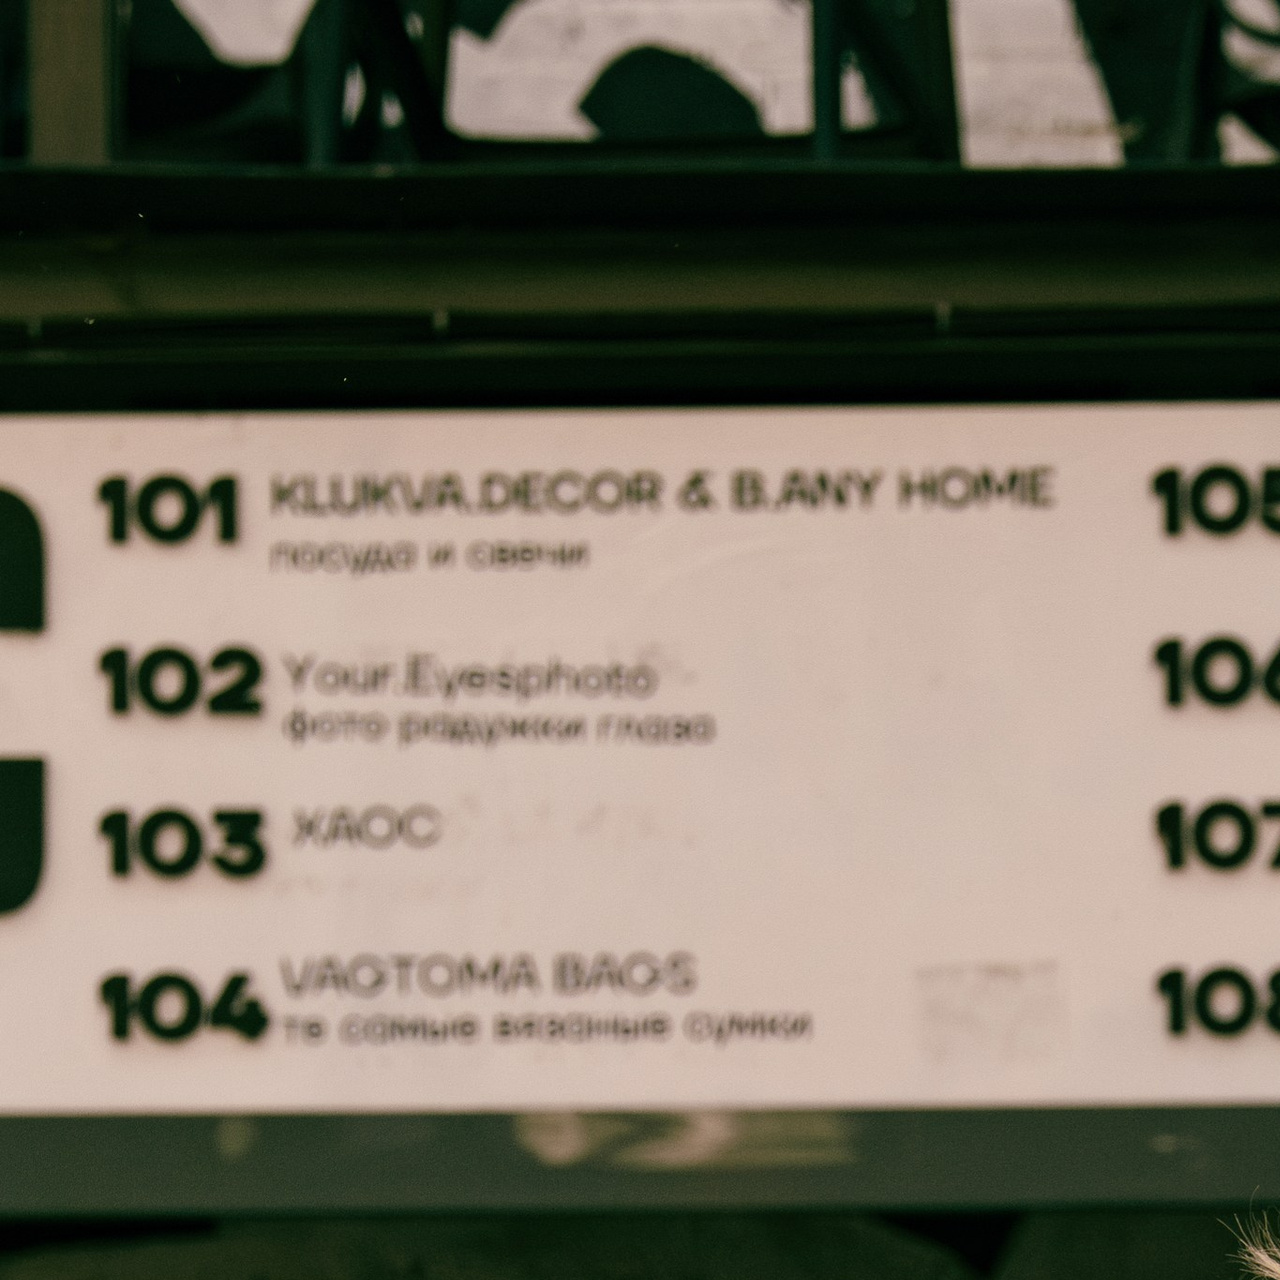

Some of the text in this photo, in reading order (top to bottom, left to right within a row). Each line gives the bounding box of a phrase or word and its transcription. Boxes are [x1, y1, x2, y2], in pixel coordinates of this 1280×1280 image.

[96, 466, 1051, 549] 101 KLUKVA.DECOR & B.ANY HOME
[270, 542, 589, 576] посуда и свечи
[97, 644, 266, 721] 102
[282, 708, 390, 744] фото
[97, 805, 439, 883] 103 ХАОС
[97, 970, 273, 1047] 104
[552, 951, 697, 996] BAGS
[684, 1013, 813, 1045] сумки
